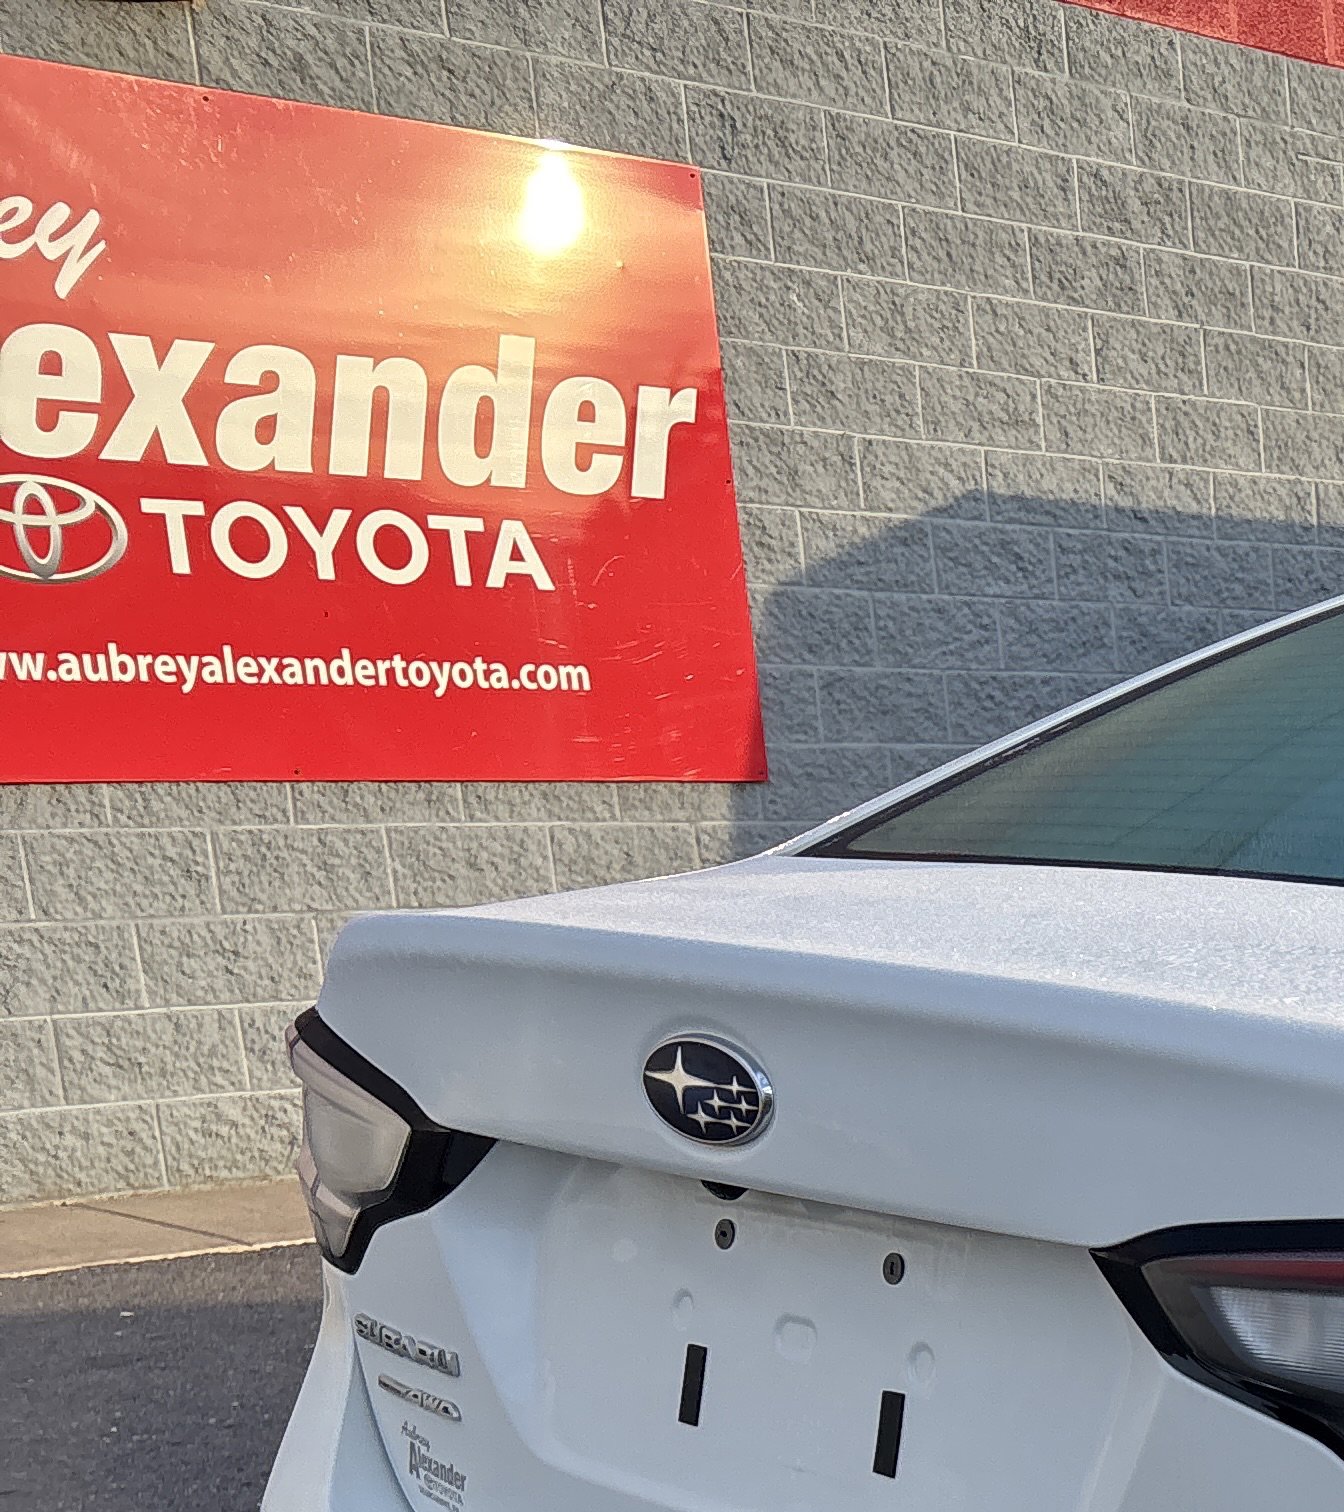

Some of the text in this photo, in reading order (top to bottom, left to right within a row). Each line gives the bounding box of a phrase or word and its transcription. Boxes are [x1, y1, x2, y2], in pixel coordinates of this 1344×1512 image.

[0, 322, 697, 500] exander
[140, 497, 555, 591] TOYOTA
[0, 643, 591, 698] w.aubreyalexandertoyota.com
[408, 1440, 467, 1492] Alexander
